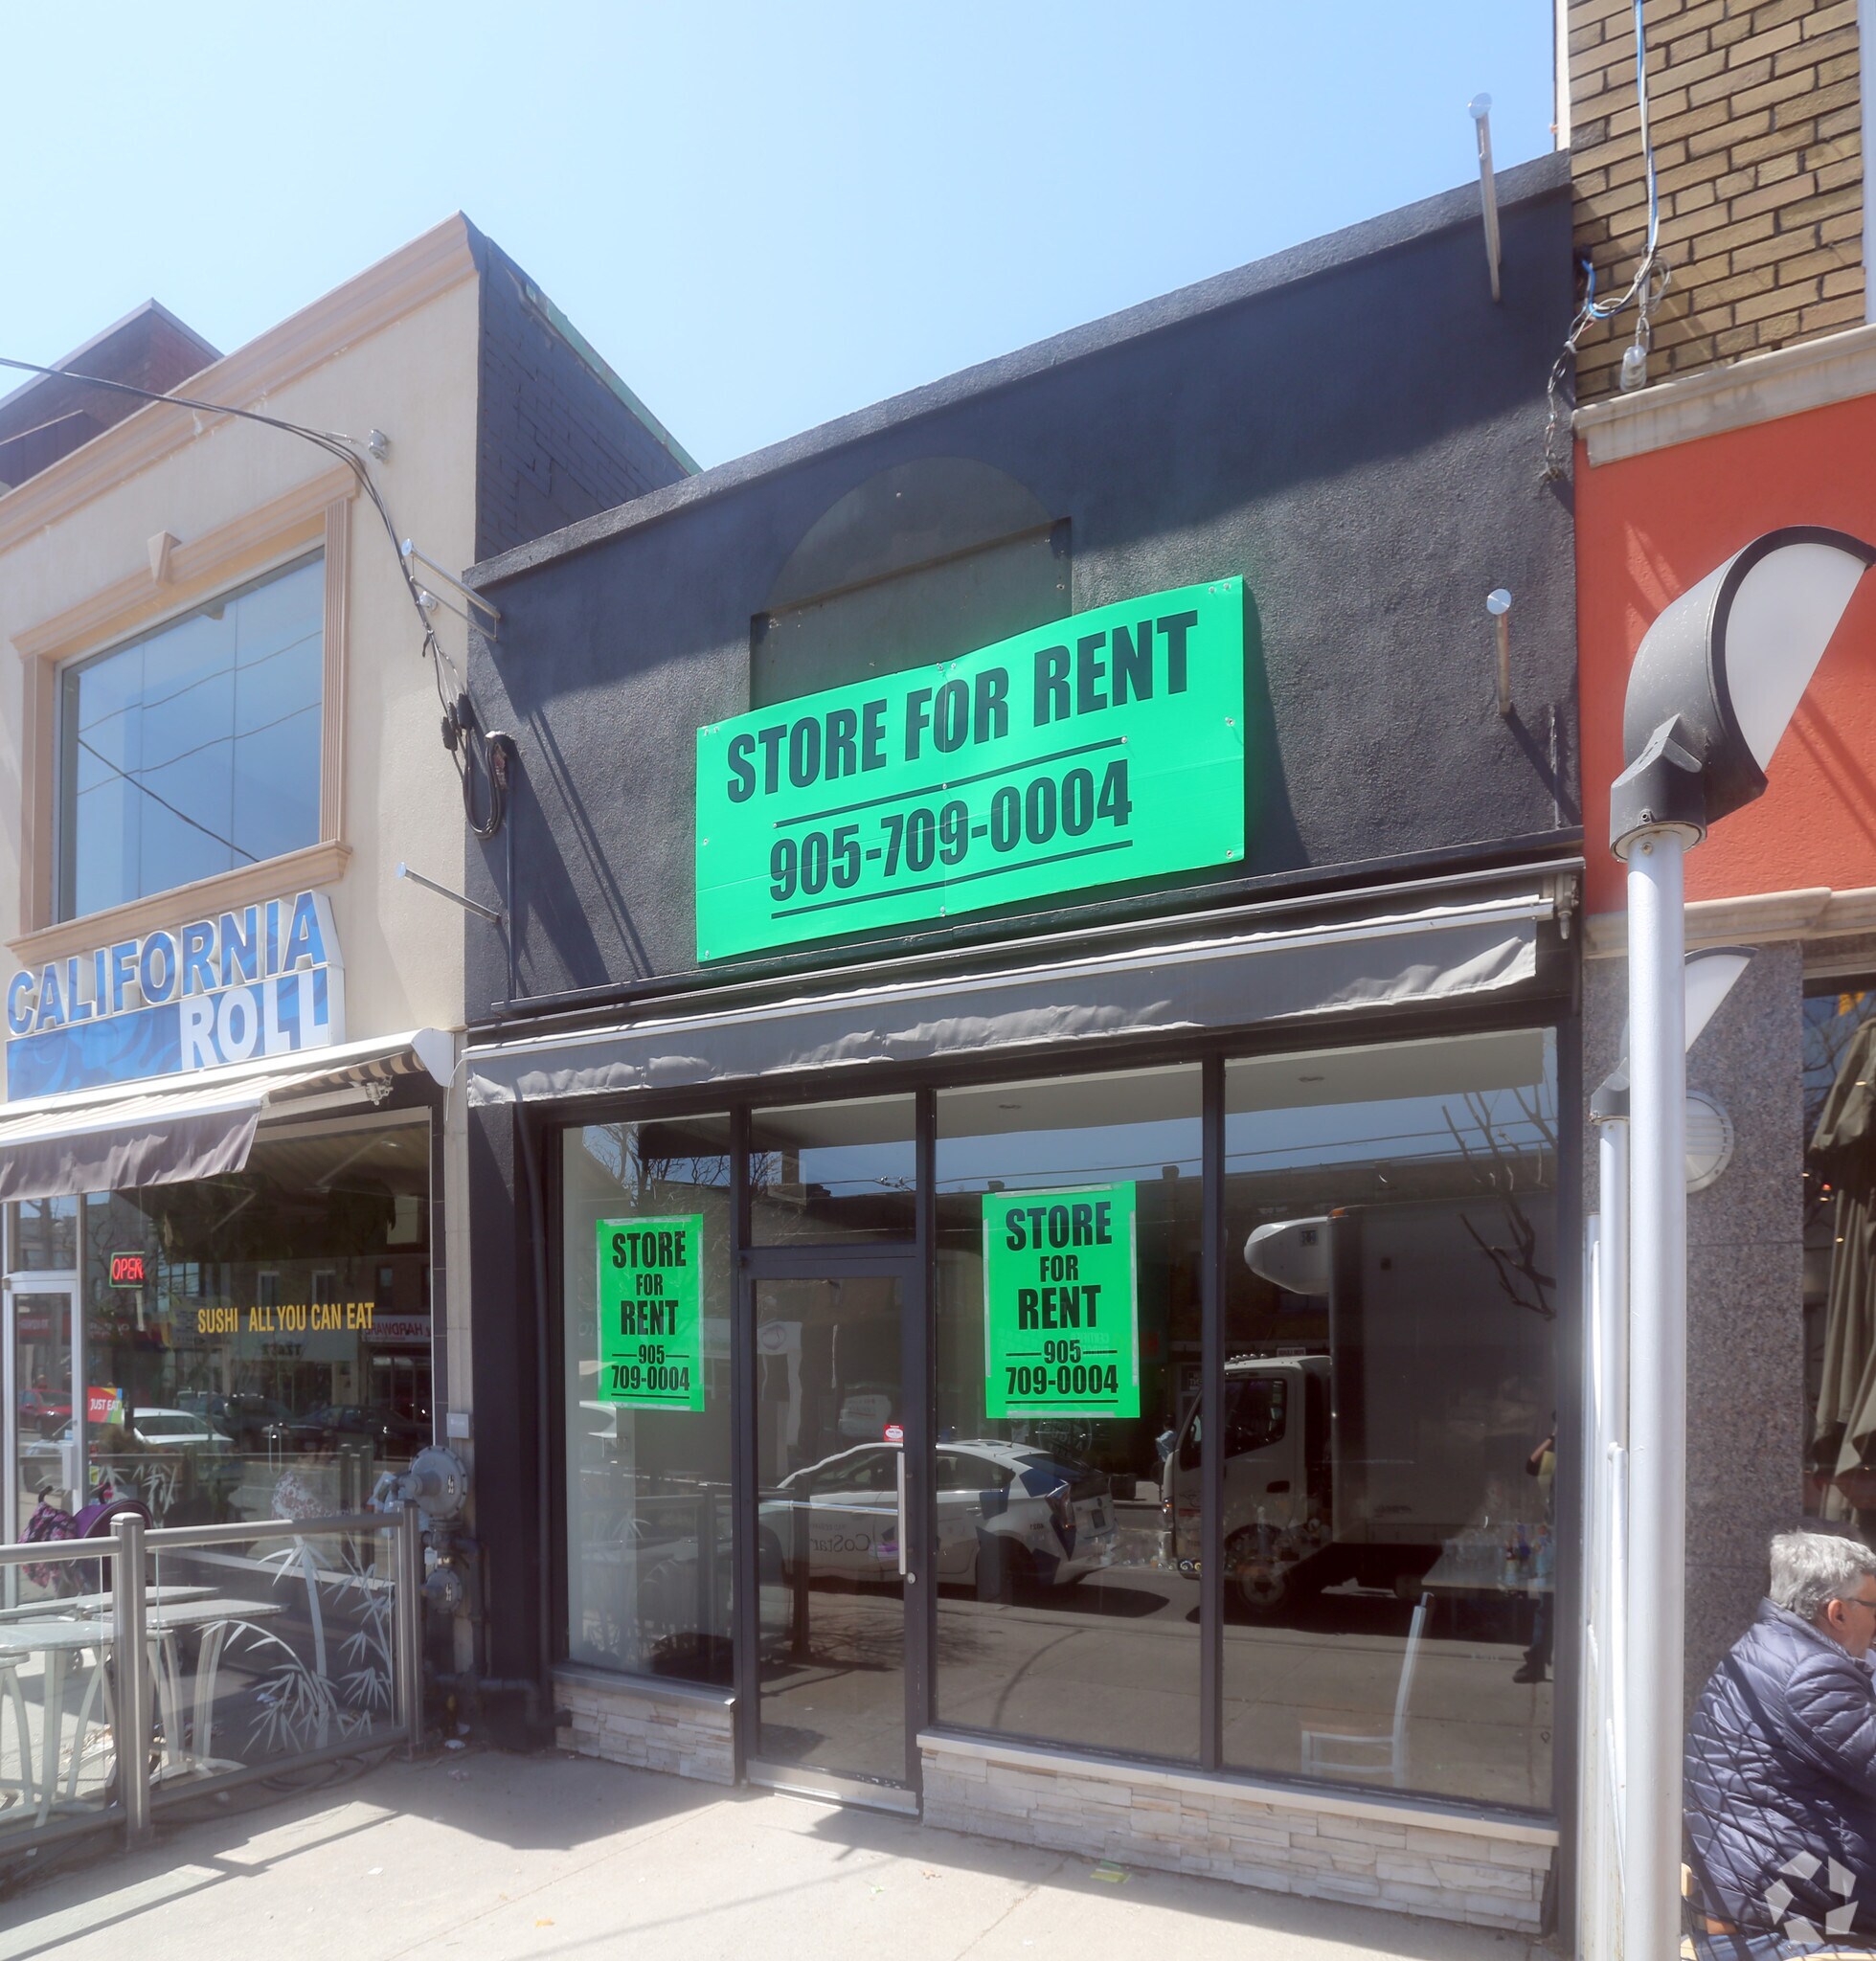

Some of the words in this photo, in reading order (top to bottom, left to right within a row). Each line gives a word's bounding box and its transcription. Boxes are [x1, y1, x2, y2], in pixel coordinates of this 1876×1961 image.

[727, 697, 888, 803] STORE
[905, 666, 1009, 761] FOR
[1033, 610, 1198, 728] RENT
[769, 758, 1133, 902] 905-709-0004
[7, 890, 331, 1037] CALIFORNIA
[179, 967, 330, 1071] ROLL
[1006, 1201, 1113, 1251] STORE
[612, 1230, 687, 1269] STORE
[112, 1257, 144, 1280] OPEN
[1040, 1254, 1079, 1283] FOR
[635, 1274, 664, 1296] FOR
[197, 1308, 238, 1333] SUSHI
[249, 1305, 275, 1332] ALL
[276, 1304, 306, 1331] YOU
[311, 1303, 342, 1331] CAN
[347, 1302, 374, 1329] EAT
[621, 1299, 679, 1336] RENT
[1018, 1284, 1101, 1330] RENT
[638, 1344, 665, 1364] 905
[1044, 1340, 1081, 1364] 905
[611, 1365, 690, 1391] 709-0004
[1006, 1364, 1119, 1395] 709-0004
[90, 1398, 106, 1411] JUST
[107, 1399, 121, 1411] EAT
